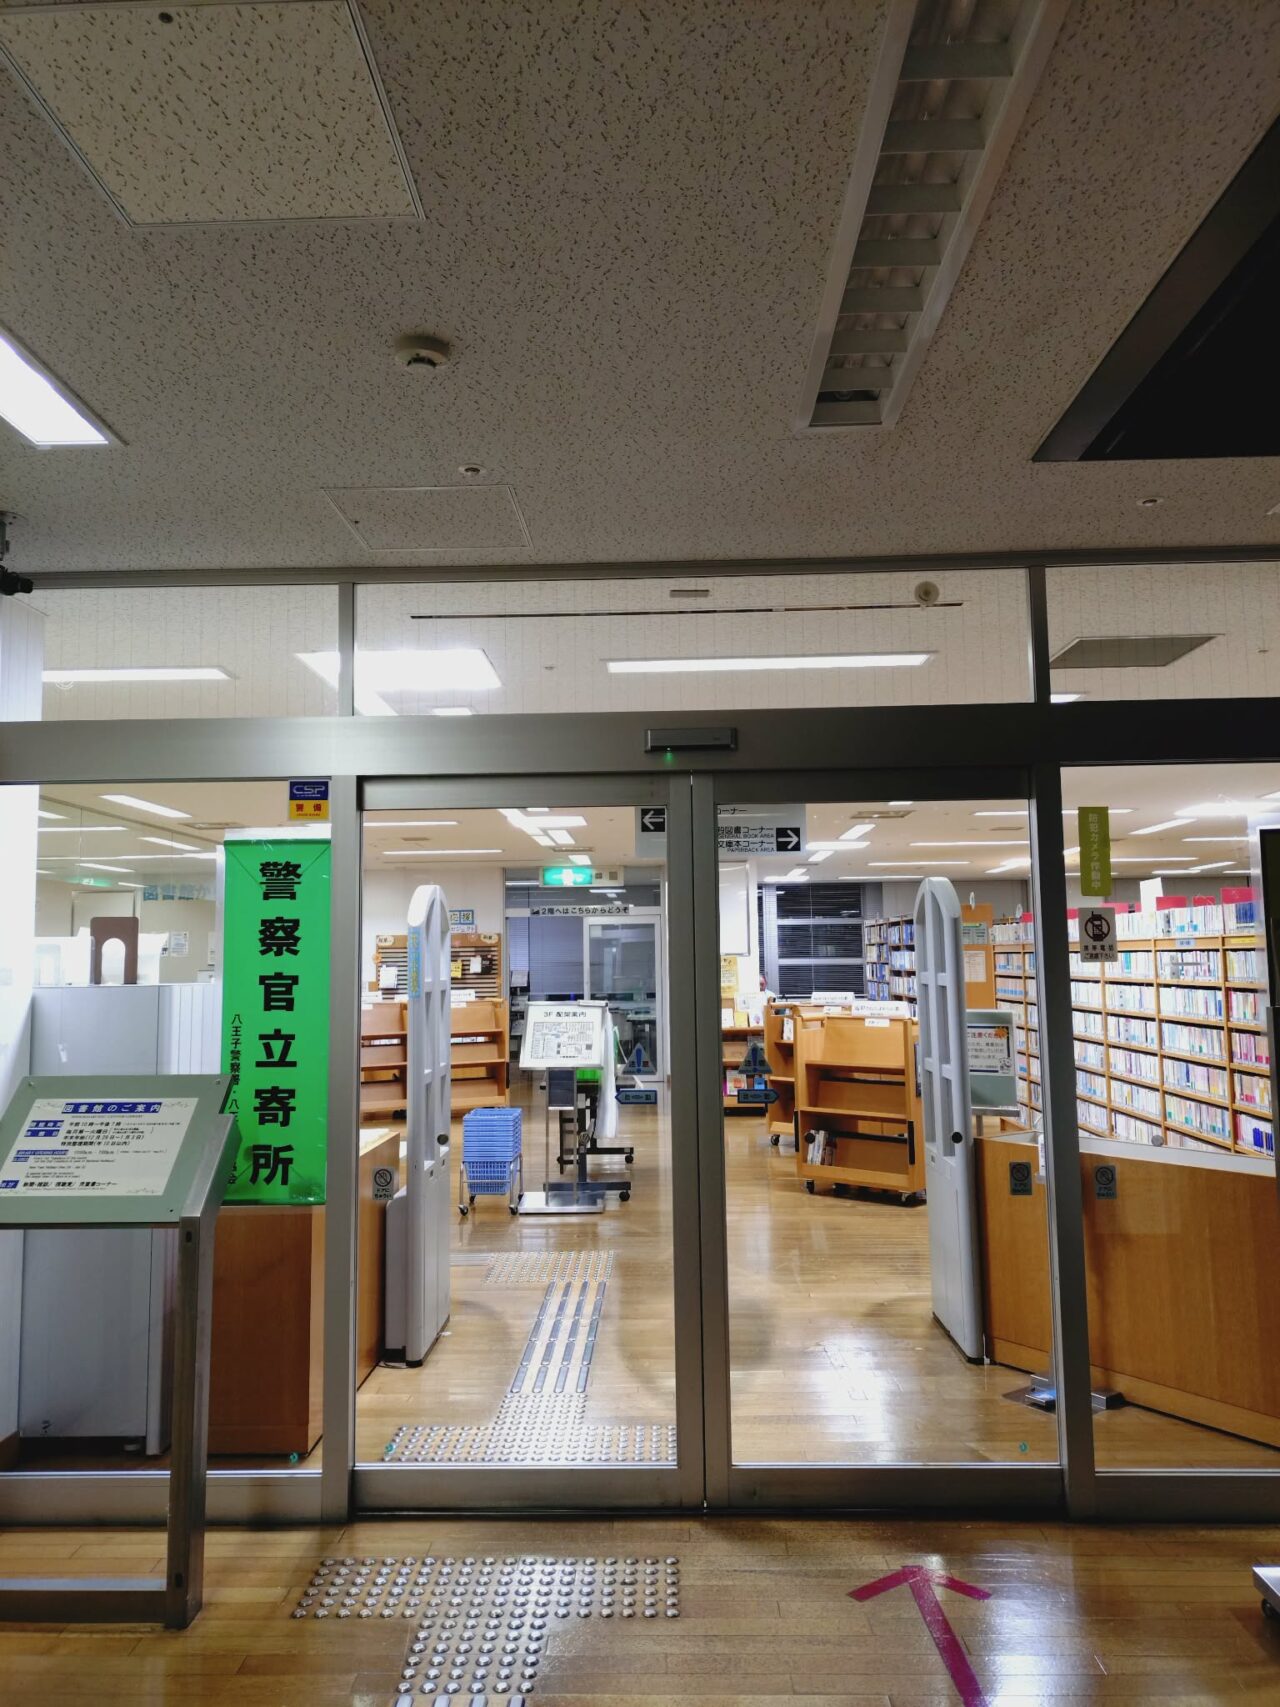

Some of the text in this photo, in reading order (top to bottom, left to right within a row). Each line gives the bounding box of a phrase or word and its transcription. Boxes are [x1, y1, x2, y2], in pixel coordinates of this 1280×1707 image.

[293, 785, 326, 794] CSP
[541, 907, 630, 915] 2階へはこちらからどうぞ
[249, 861, 302, 1186] 警察官立寄所
[63, 1104, 161, 1113] 図書館のご案内
